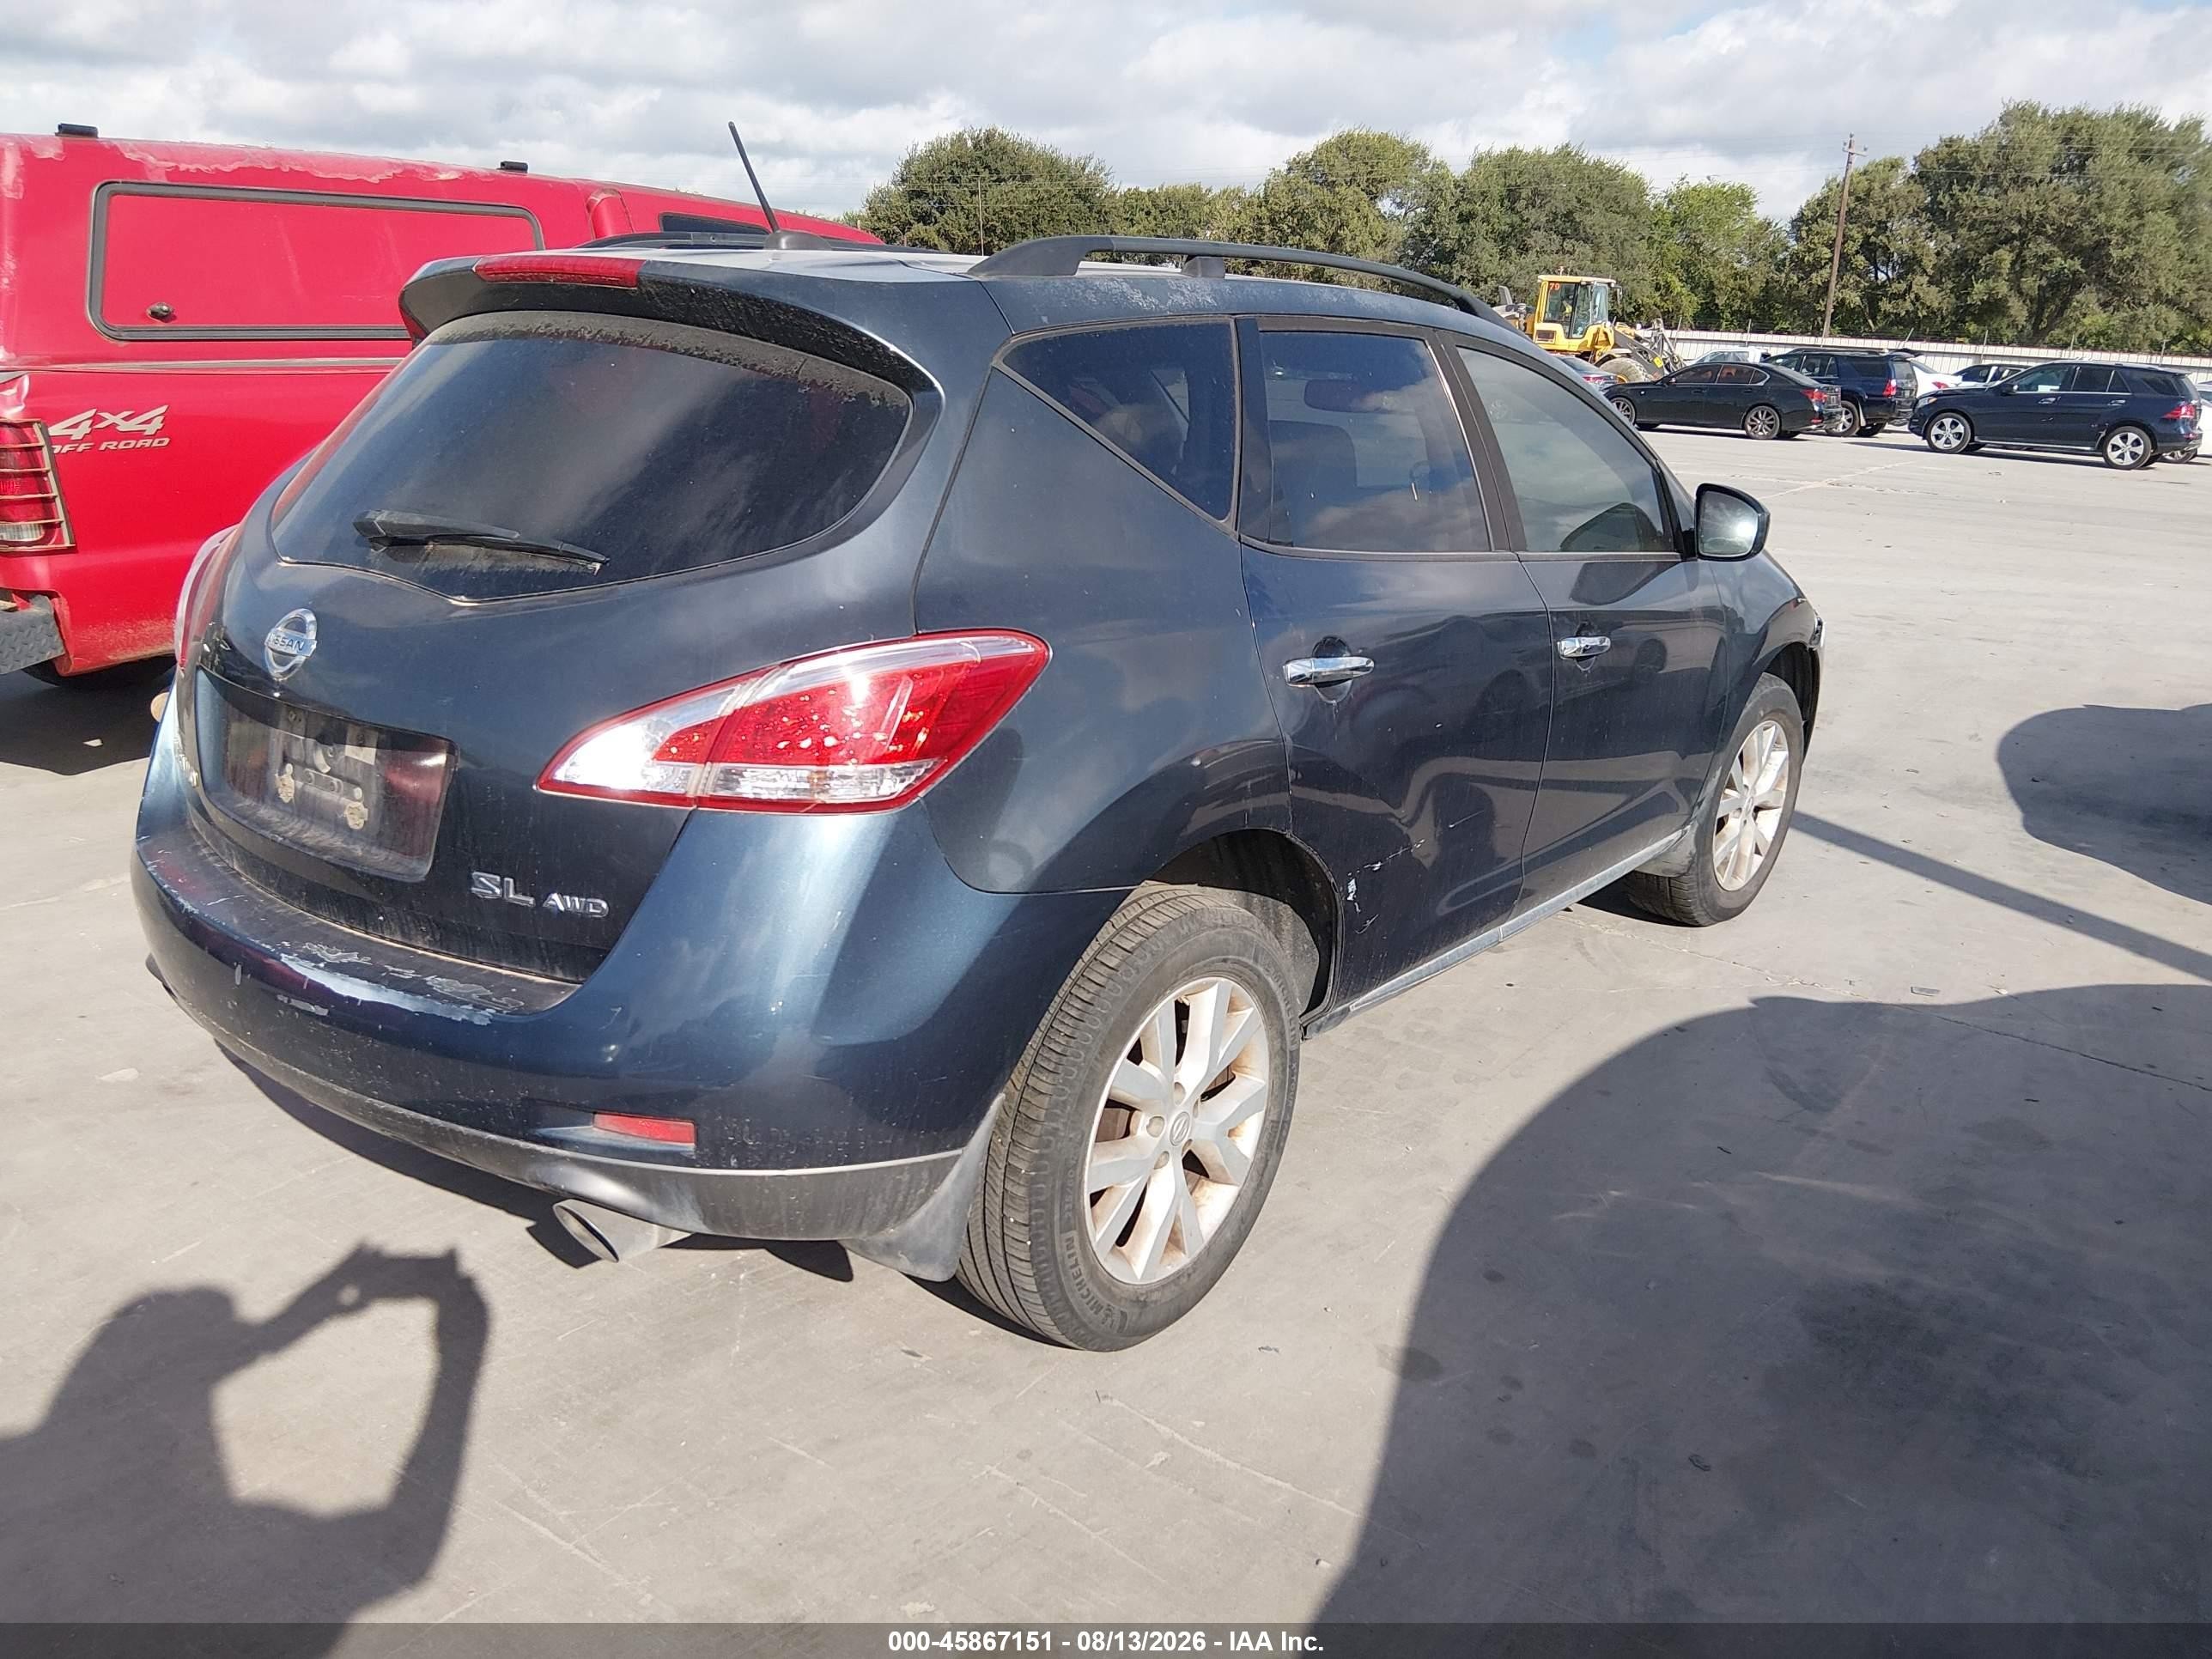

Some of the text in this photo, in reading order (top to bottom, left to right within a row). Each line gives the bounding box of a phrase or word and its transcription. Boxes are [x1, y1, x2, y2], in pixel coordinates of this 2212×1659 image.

[99, 437, 170, 450] ROAD
[471, 871, 610, 918] SL AWD
[1064, 1236, 1105, 1316] MICHELIN
